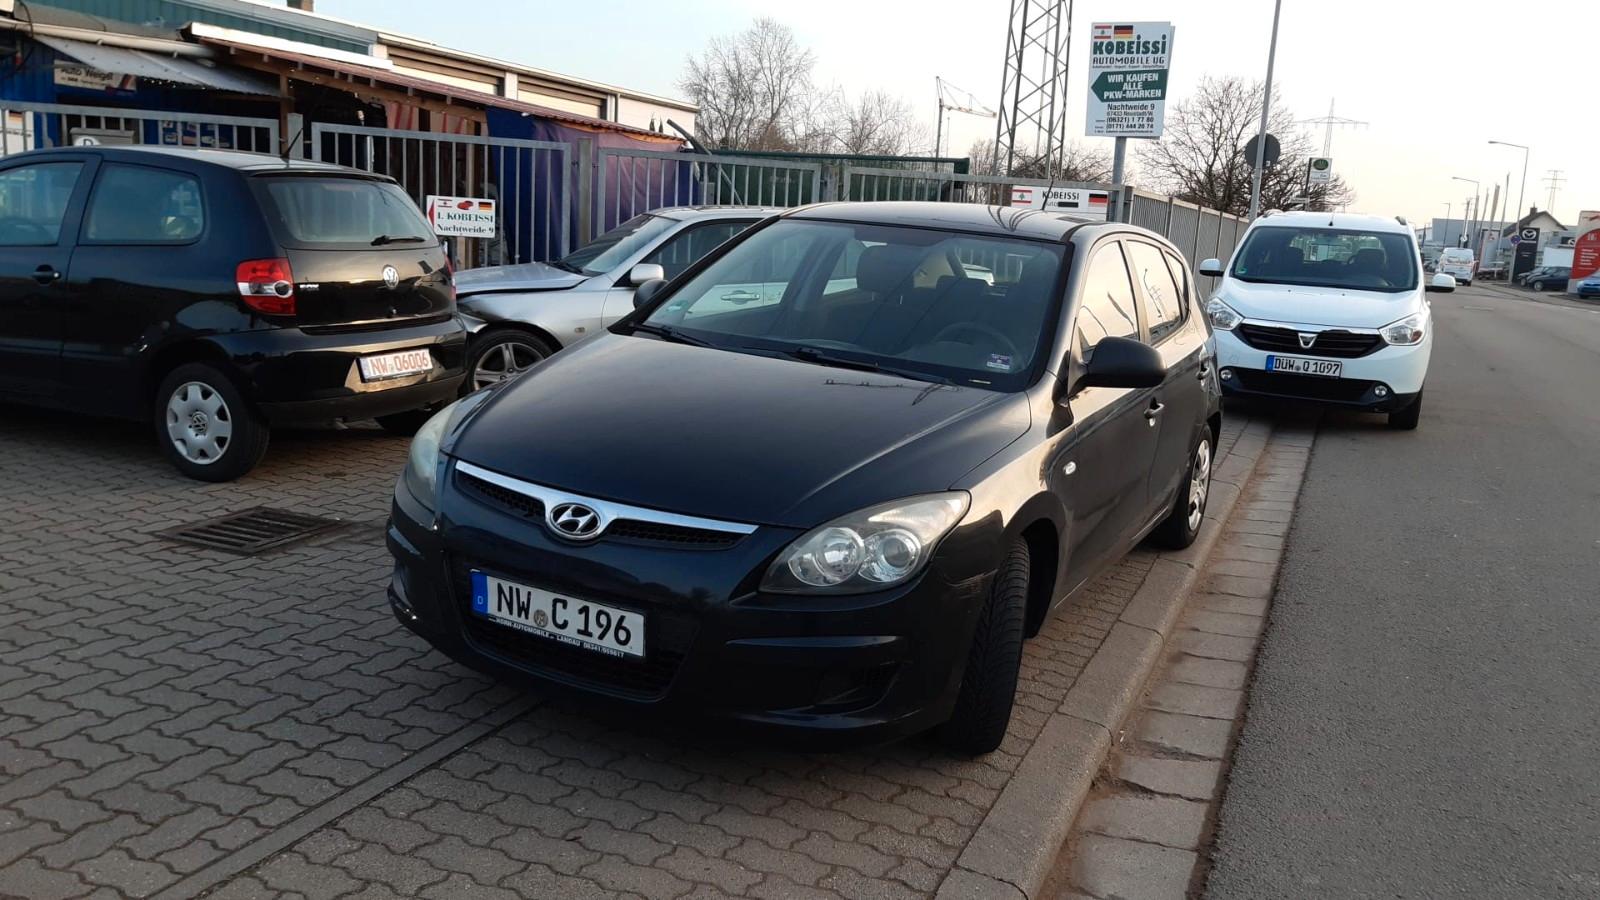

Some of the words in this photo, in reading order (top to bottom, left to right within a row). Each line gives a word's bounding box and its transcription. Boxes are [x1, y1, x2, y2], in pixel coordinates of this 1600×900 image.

[1093, 56, 1150, 65] AUTOMOBILE
[1153, 56, 1165, 65] UG
[1108, 74, 1124, 83] WIR
[1126, 73, 1159, 82] KAUFEN
[1122, 82, 1143, 90] ALLE
[1103, 89, 1161, 99] PKW-MARKEN
[1107, 103, 1148, 111] Nachtweide
[1042, 191, 1079, 200] KOBEISSI
[447, 213, 494, 222] KOBEISSI
[437, 224, 486, 233] Nachtweide
[370, 358, 388, 376] NW
[393, 352, 429, 372] 06006
[1274, 358, 1296, 371] DÜW
[1312, 362, 1340, 375] 1097
[477, 595, 484, 605] D
[497, 582, 532, 621] NW
[552, 598, 569, 630] C
[577, 605, 632, 647] 196
[556, 634, 581, 647] LANDAU
